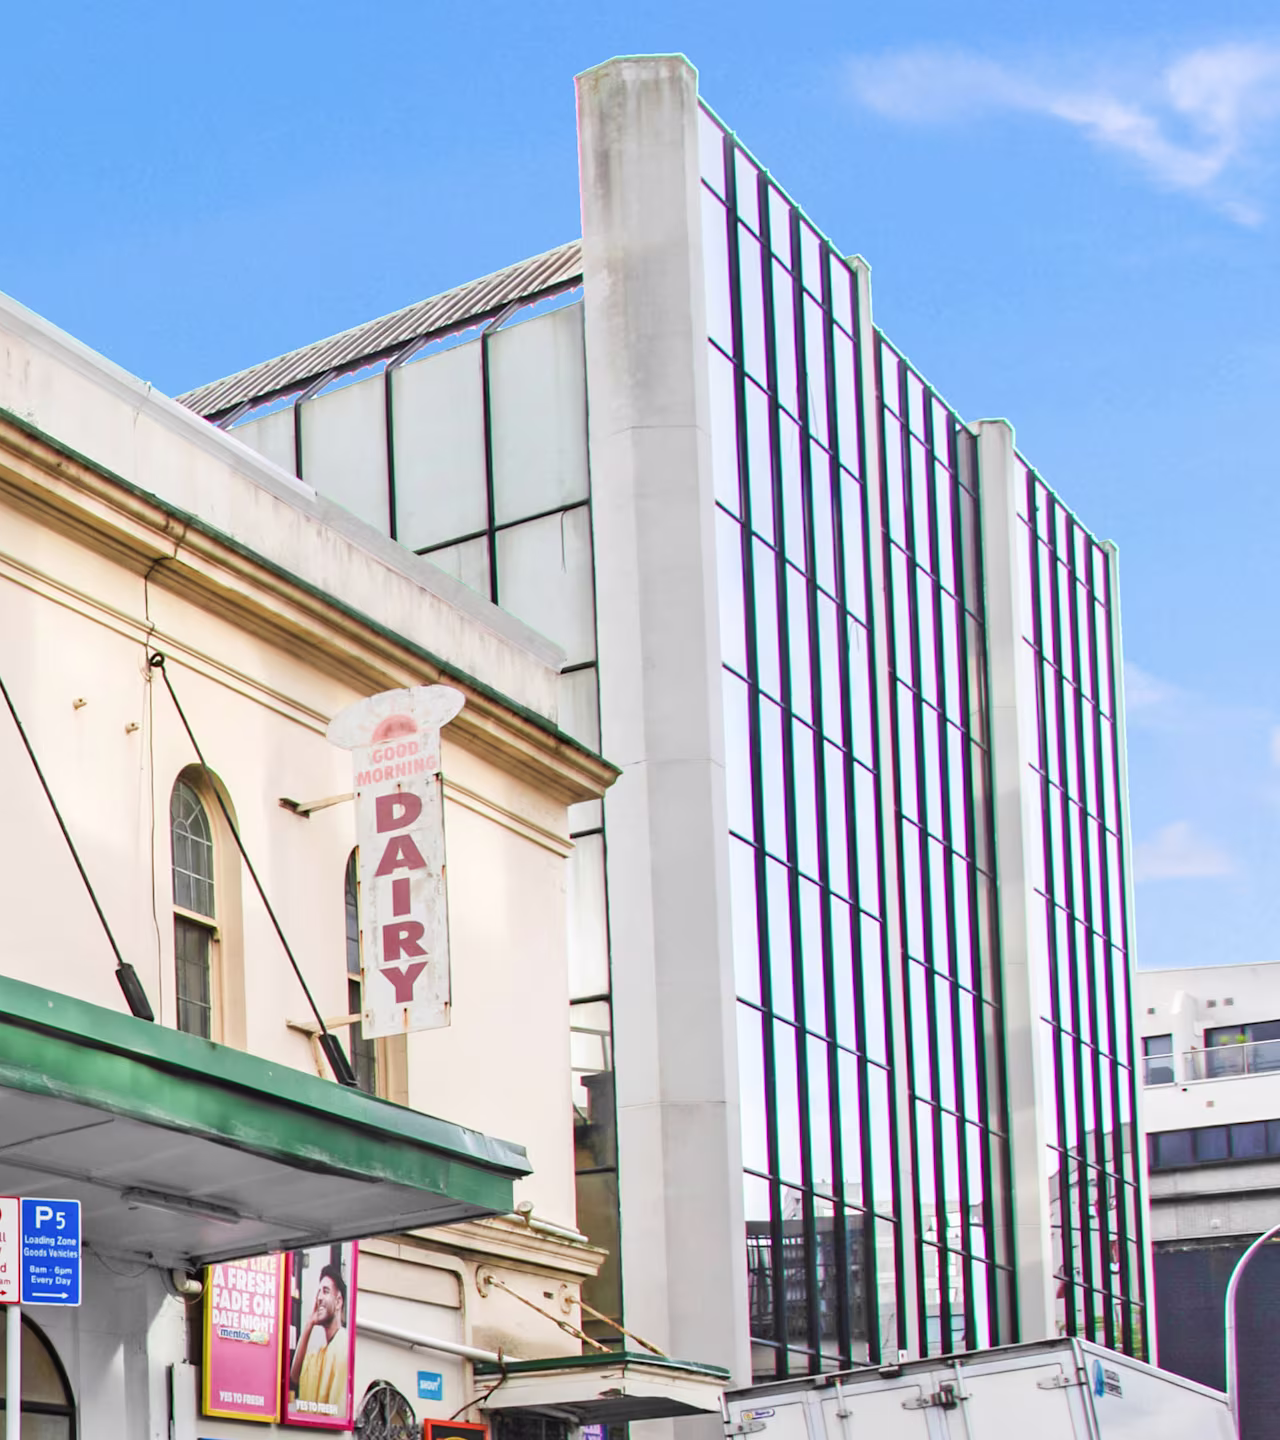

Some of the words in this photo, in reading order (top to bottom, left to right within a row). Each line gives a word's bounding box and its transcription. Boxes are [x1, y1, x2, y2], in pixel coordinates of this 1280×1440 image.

[372, 740, 420, 765] GOOD
[356, 754, 438, 787] MORNING
[374, 791, 429, 1004] DAIRY
[24, 1235, 55, 1246] Loading
[57, 1236, 77, 1246] Zone
[24, 1248, 47, 1257] Goods
[30, 1265, 47, 1274] 8am
[54, 1266, 72, 1275] 6pm
[31, 1275, 53, 1285] Every
[55, 1276, 71, 1286] Day
[212, 1265, 225, 1287] A
[228, 1268, 276, 1297] FRESH
[212, 1287, 251, 1312] FADE
[253, 1295, 275, 1317] ON
[212, 1309, 240, 1328] DATE
[241, 1313, 275, 1334] NIGHT
[220, 1327, 251, 1340] mentos
[219, 1391, 232, 1402] YES
[233, 1392, 242, 1404] TO
[243, 1393, 265, 1406] FRESH
[296, 1399, 309, 1412] YES
[310, 1401, 318, 1412] TO
[318, 1402, 338, 1415] FRESH
